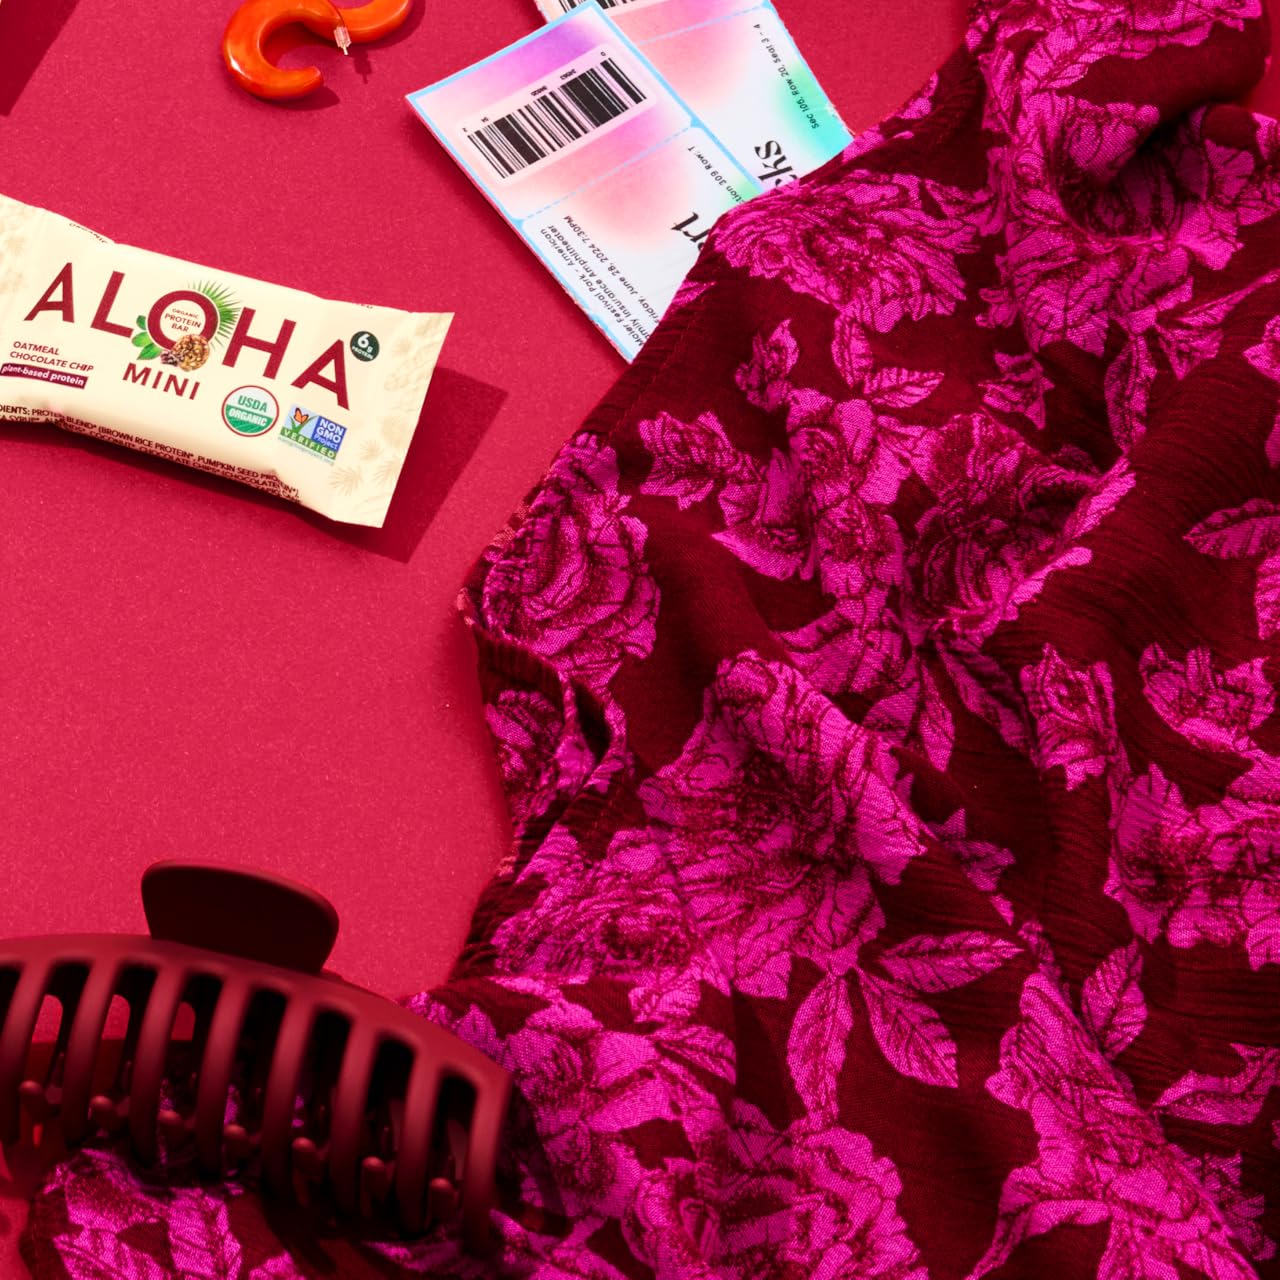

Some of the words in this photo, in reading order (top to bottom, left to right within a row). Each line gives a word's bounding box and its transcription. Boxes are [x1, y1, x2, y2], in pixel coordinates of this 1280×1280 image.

[766, 45, 781, 63] Seat
[778, 65, 789, 77] 20,
[786, 79, 800, 96] Row
[806, 113, 819, 129] Sec
[694, 152, 712, 170] Row:
[710, 171, 726, 185] 309
[726, 185, 745, 203] tion
[563, 215, 590, 243] 7:30PM
[540, 228, 574, 266] American
[548, 225, 596, 278] Amphitheater
[588, 243, 608, 263] 2024
[608, 262, 620, 276] 28,
[579, 274, 595, 292] Park
[619, 277, 638, 295] June
[594, 292, 621, 322] Festival
[596, 279, 631, 318] Insurance
[165, 313, 202, 328] PROTEIN
[171, 323, 189, 332] BAR
[630, 318, 650, 339] amily
[24, 262, 350, 410] ALOHA
[357, 333, 373, 353] 6g
[623, 323, 643, 346] Maier
[13, 341, 60, 356] OATMEAL
[351, 346, 374, 360] PROTEIN
[10, 351, 68, 368] CHOCOLATE
[69, 361, 94, 372] CHIP
[1, 364, 50, 379] plant-based
[50, 373, 85, 386] protein
[122, 362, 200, 400] MINI
[238, 395, 268, 413] USDA
[228, 408, 268, 426] ORGANIC
[316, 427, 341, 444] GMO
[320, 418, 344, 435] NON
[283, 428, 335, 458] VERIFIED
[314, 434, 338, 450] Project
[135, 437, 152, 448] RICE
[198, 456, 235, 472] PUMPKIN
[237, 467, 259, 478] SEED
